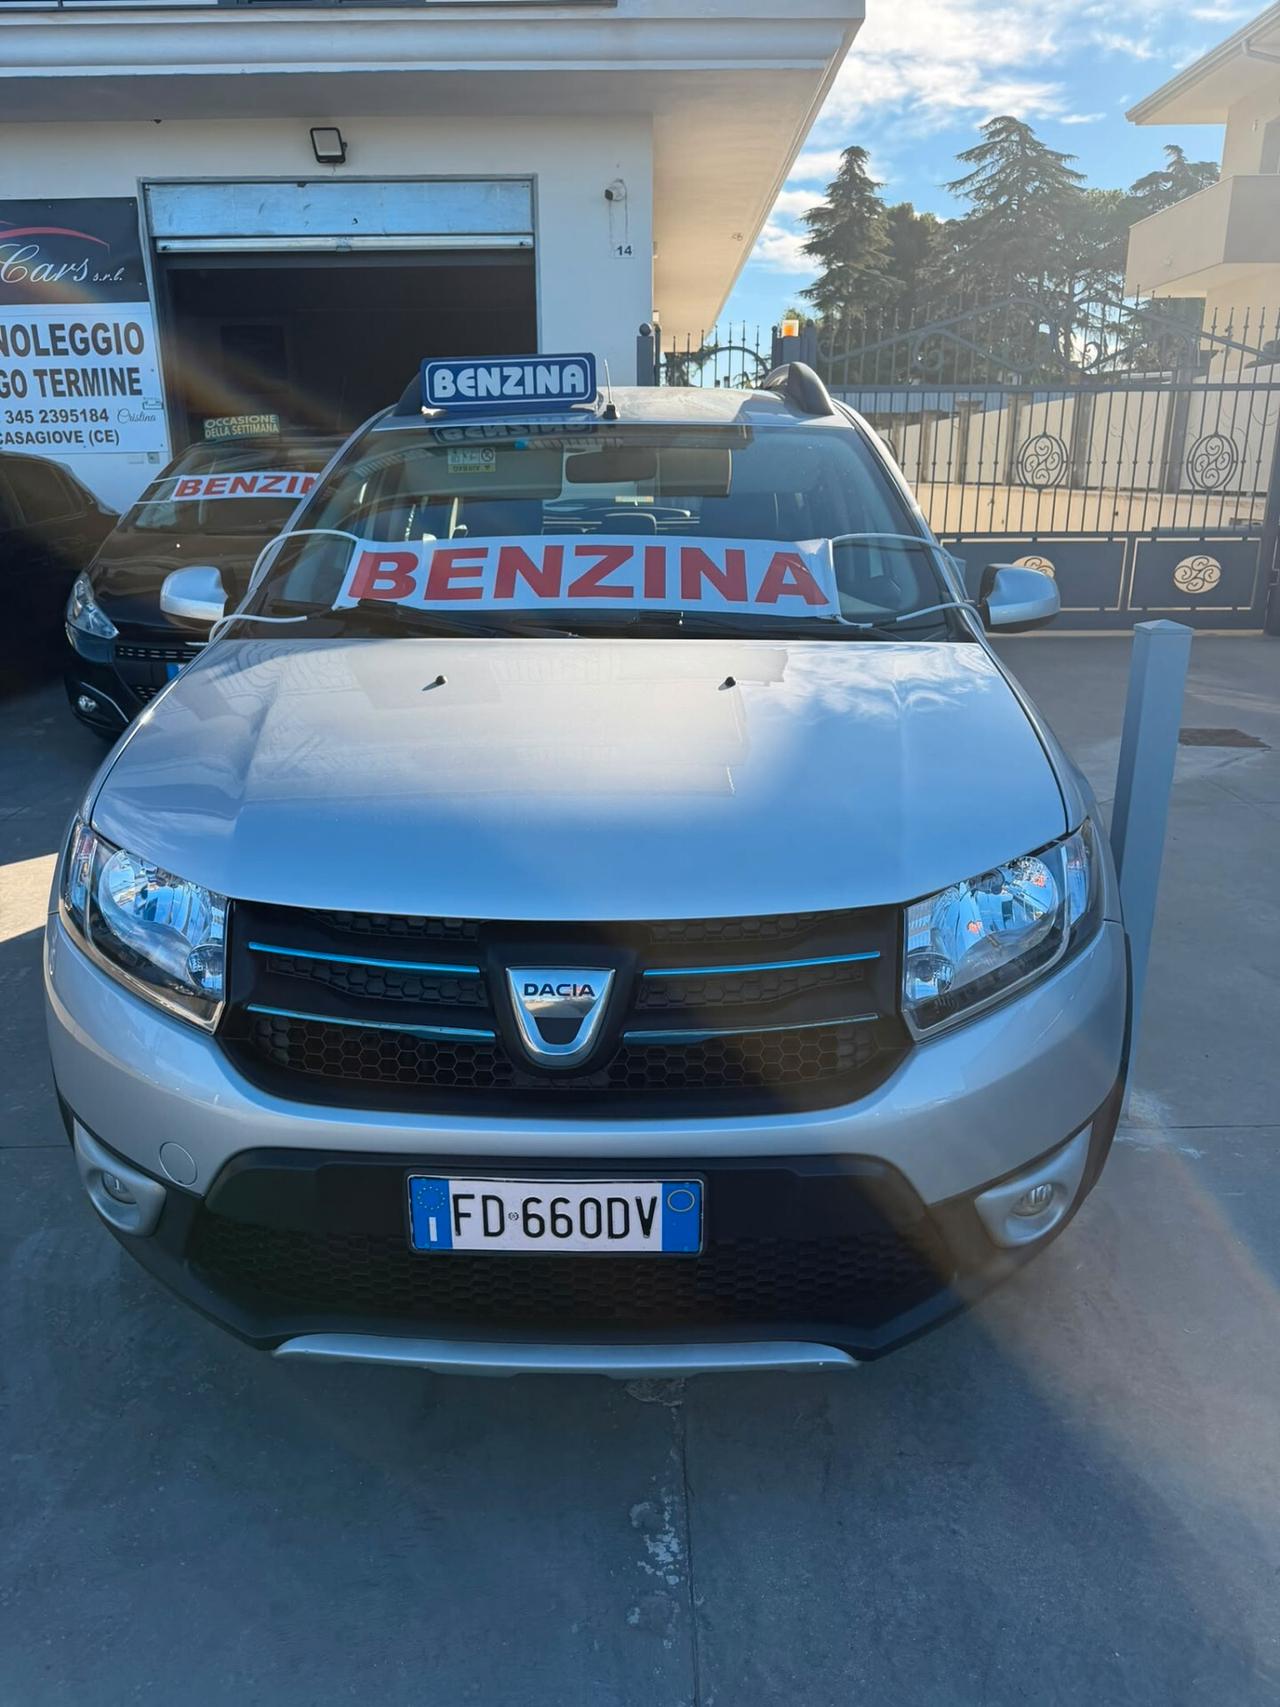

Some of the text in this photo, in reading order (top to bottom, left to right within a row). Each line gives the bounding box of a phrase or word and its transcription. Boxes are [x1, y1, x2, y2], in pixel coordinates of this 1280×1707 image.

[616, 245, 632, 256] 14
[33, 367, 143, 398] TERMINE
[433, 364, 585, 398] BENZINA
[4, 408, 109, 425] 345 2395184
[204, 414, 278, 428] OCCASIONE
[88, 428, 120, 446] (CE)
[205, 423, 280, 439] DELLA SETTIMANA
[347, 545, 831, 606] BENZINA
[524, 983, 595, 997] DACIA
